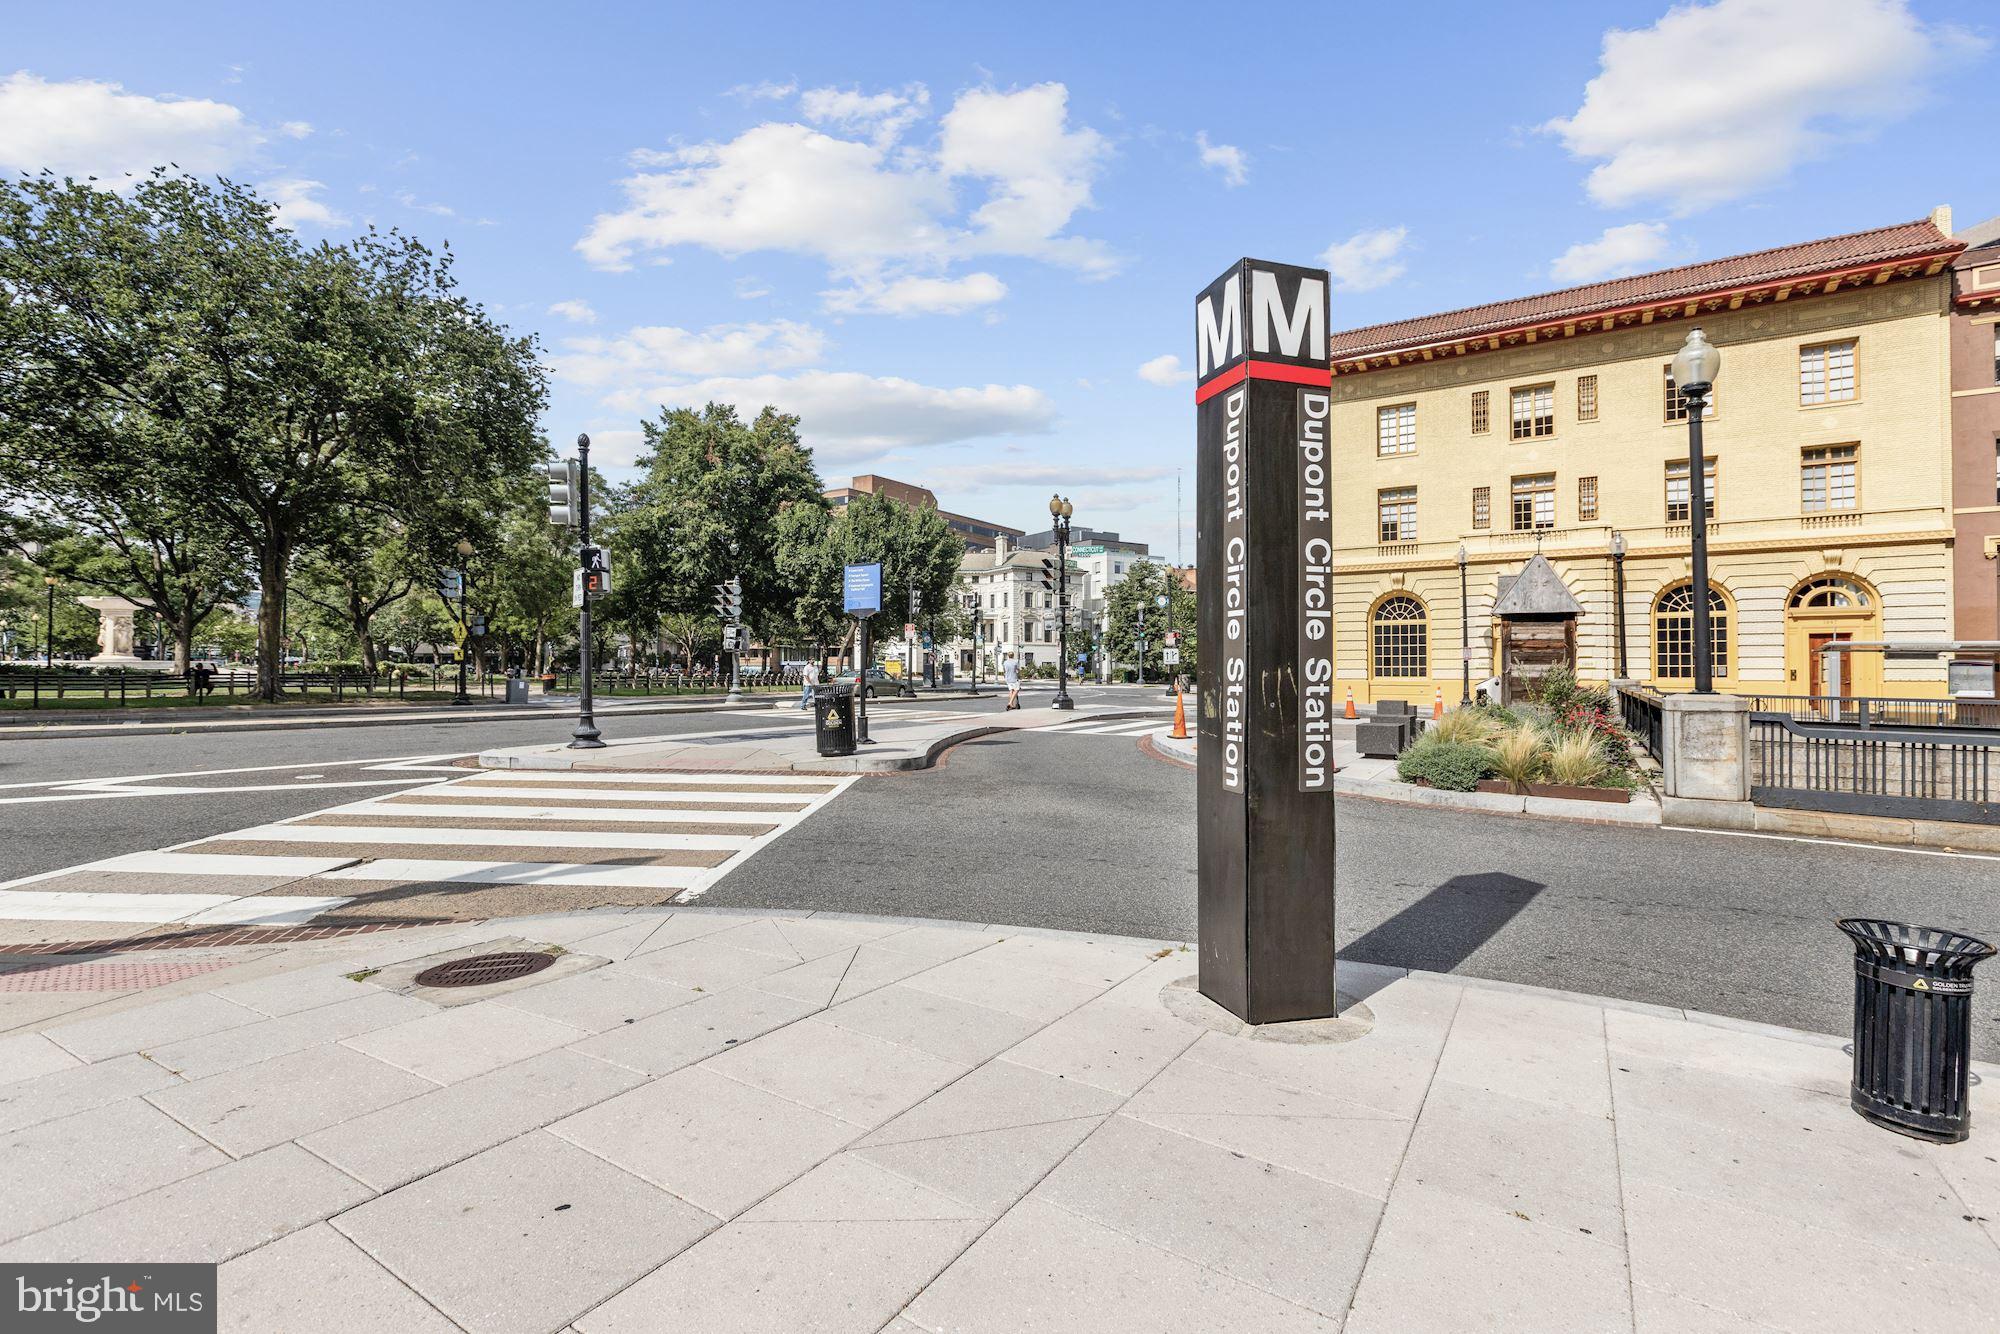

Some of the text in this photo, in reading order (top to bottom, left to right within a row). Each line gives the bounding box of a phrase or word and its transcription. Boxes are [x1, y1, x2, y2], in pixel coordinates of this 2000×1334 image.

[1198, 272, 1242, 379] M
[1252, 270, 1325, 360] M
[1224, 389, 1245, 788] Dupont Circle Station
[1300, 393, 1332, 788] Dupont Circle Station
